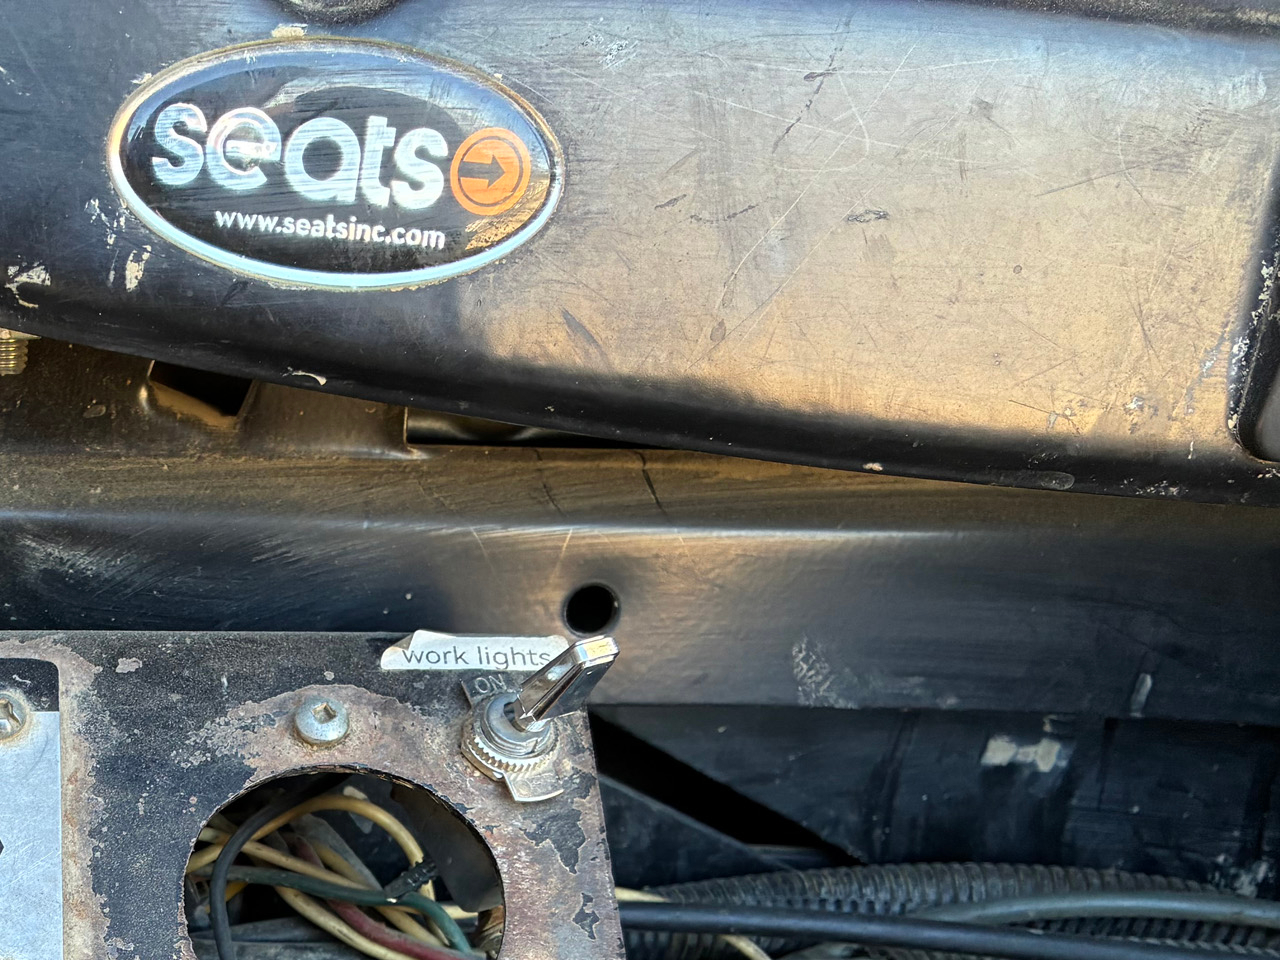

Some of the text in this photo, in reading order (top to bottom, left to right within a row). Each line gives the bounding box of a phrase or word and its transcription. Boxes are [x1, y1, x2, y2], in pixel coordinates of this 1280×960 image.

[151, 101, 449, 210] seats
[214, 209, 447, 250] www.seatsinc.com
[402, 646, 551, 669] work lights
[474, 673, 508, 694] ON
